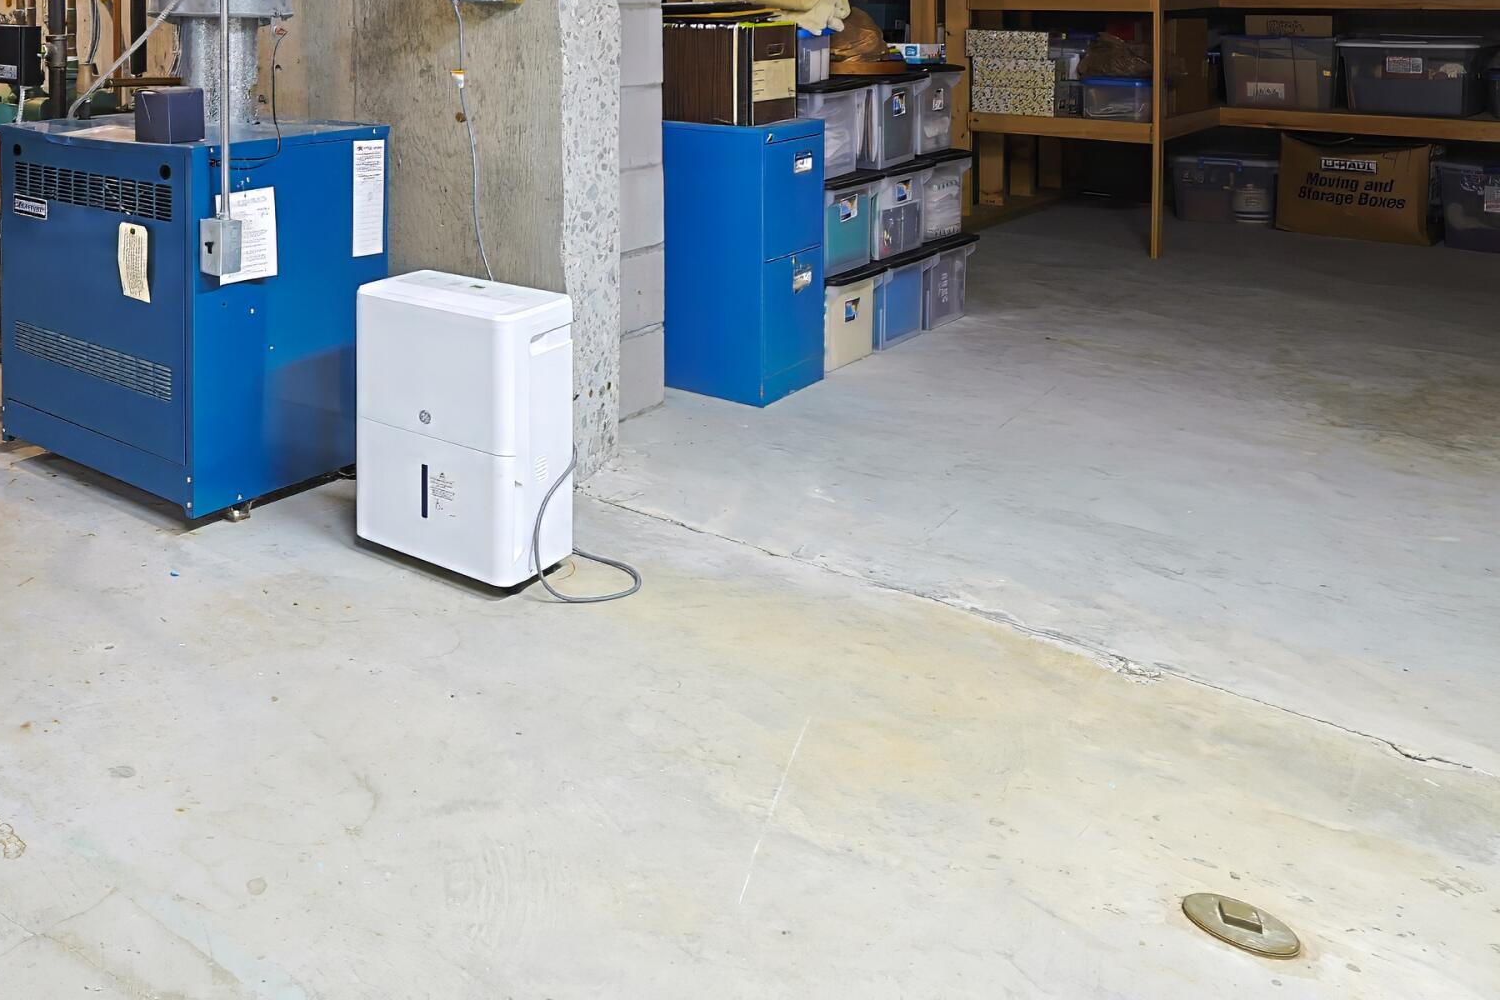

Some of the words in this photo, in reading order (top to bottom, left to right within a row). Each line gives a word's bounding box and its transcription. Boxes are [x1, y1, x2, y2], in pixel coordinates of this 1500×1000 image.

[1306, 172, 1359, 192] Moving
[1364, 180, 1395, 192] and
[1298, 186, 1354, 206] Storage
[1358, 193, 1406, 209] Boxes
